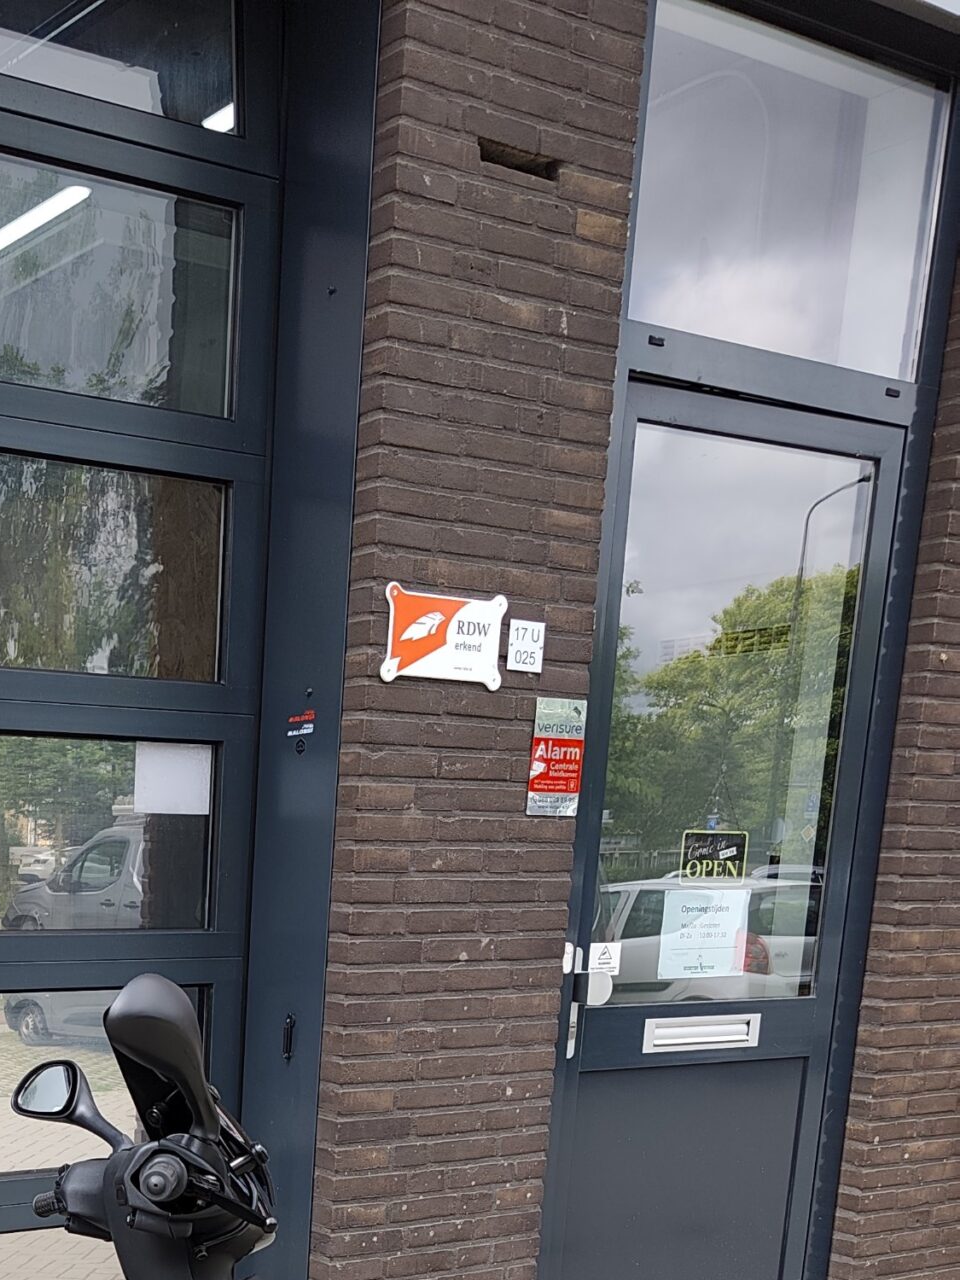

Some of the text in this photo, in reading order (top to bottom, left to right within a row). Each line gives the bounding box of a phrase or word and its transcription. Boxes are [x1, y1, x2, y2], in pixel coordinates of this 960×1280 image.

[456, 620, 492, 637] RDW
[514, 627, 540, 643] 17 U
[454, 641, 482, 653] erkend
[514, 649, 536, 666] 025
[537, 722, 583, 735] verisure
[534, 740, 580, 761] Alarm
[686, 859, 740, 879] OPEN
[681, 904, 730, 914] Openingstijden
